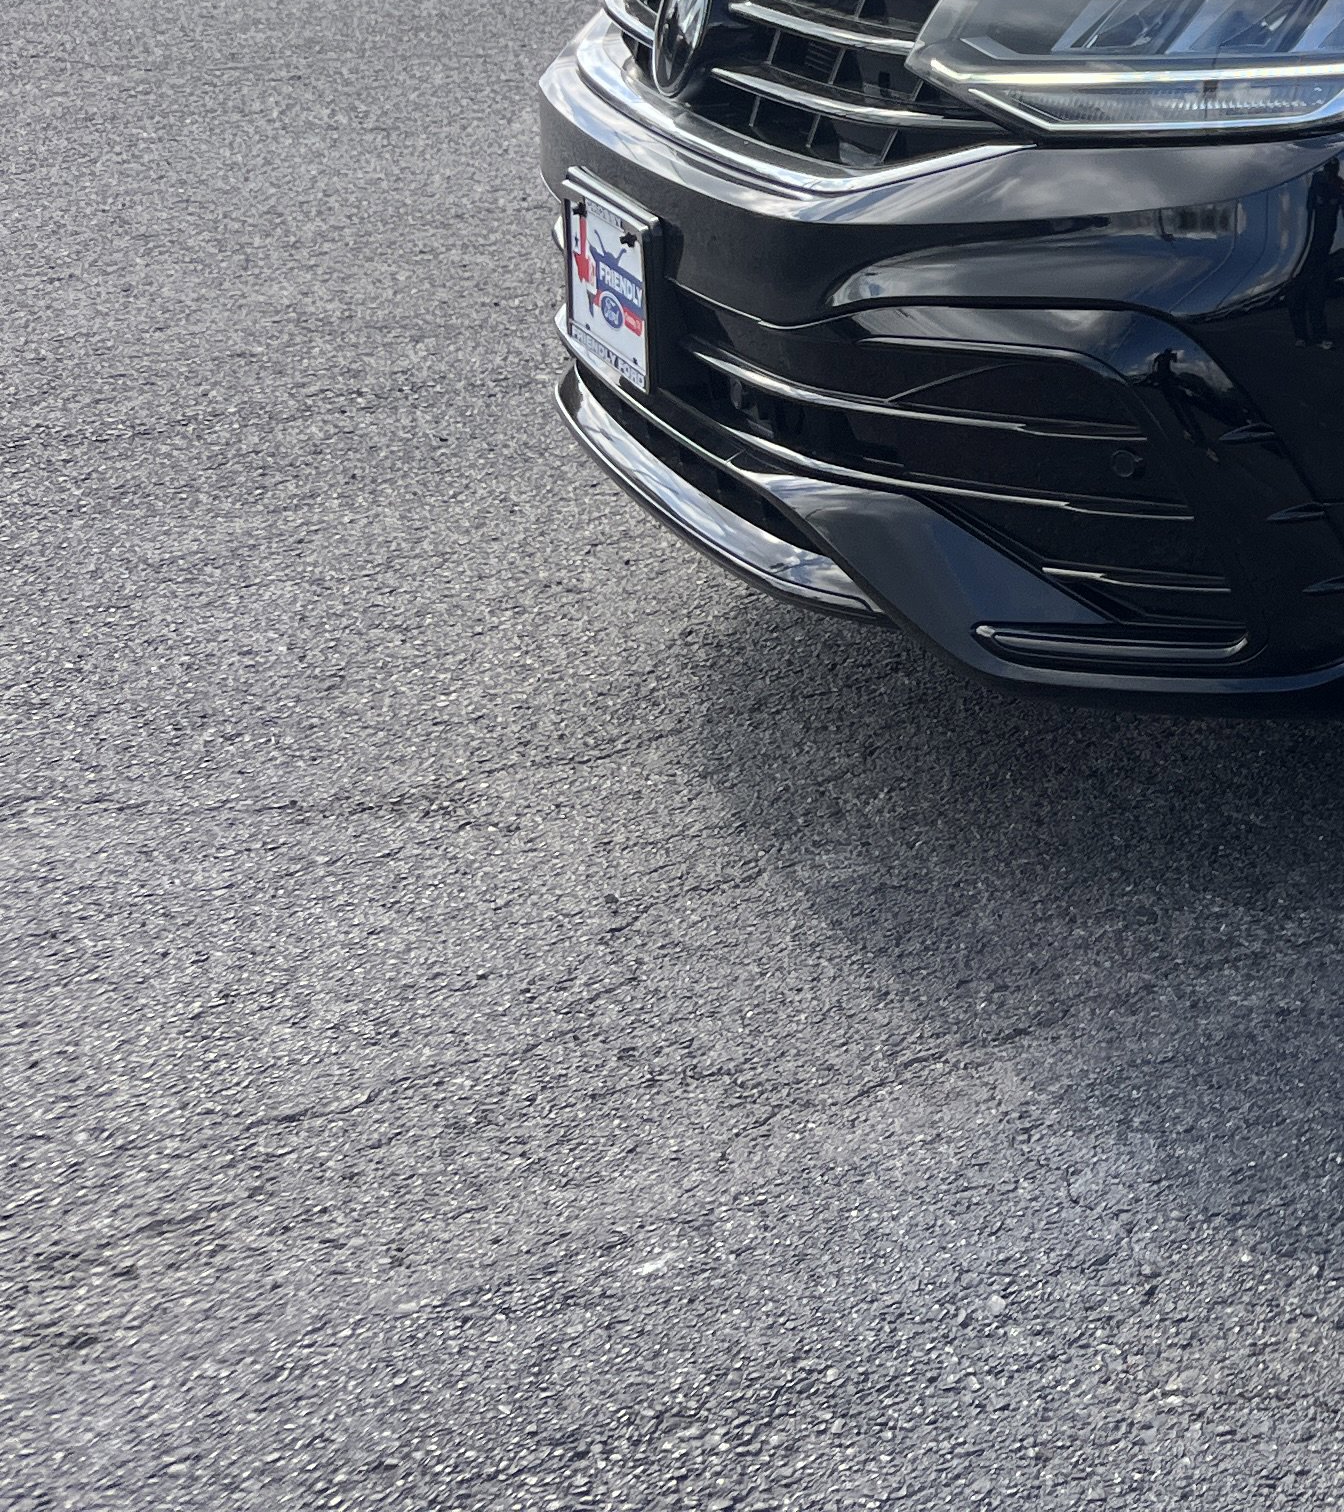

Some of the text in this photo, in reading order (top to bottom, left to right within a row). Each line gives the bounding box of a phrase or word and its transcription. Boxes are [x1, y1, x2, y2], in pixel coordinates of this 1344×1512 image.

[599, 261, 643, 308] FRIENDLY
[604, 297, 620, 325] Ford
[571, 324, 645, 388] FRIENDLY FORD
